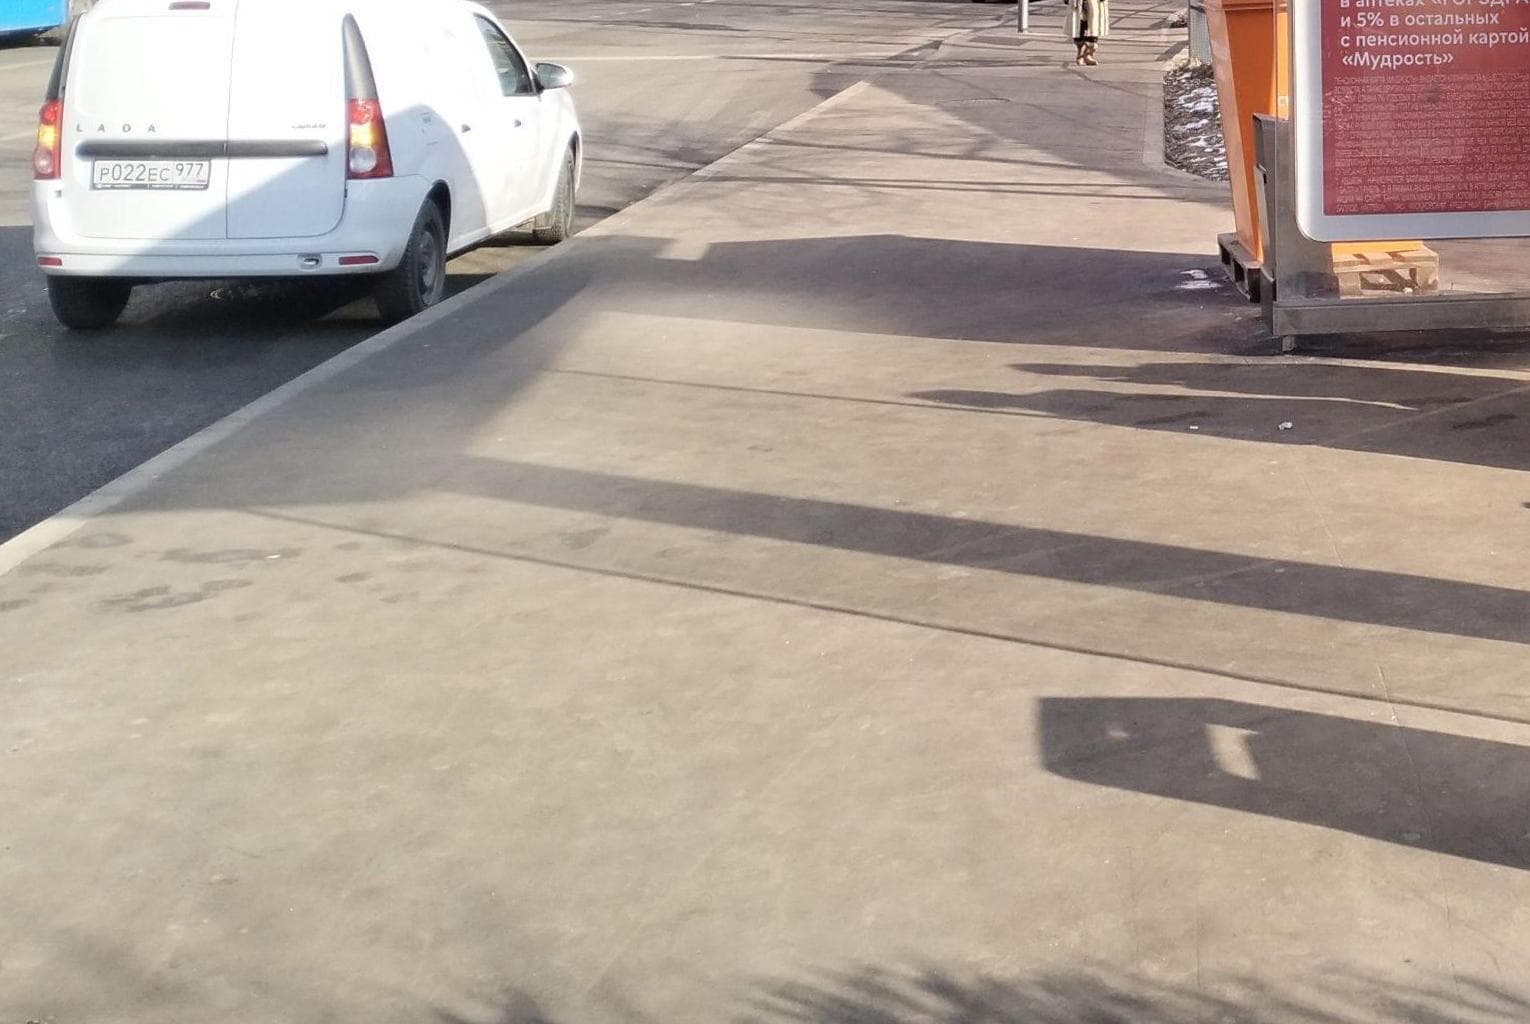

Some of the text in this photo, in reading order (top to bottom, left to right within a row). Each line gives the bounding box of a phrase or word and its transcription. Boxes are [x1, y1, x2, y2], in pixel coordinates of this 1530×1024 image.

[1340, 12, 1500, 28] и 5% в остальных
[1340, 27, 1529, 48] с пенсионной картой
[1342, 50, 1454, 70] «Мудрость»
[75, 123, 157, 134] LADA
